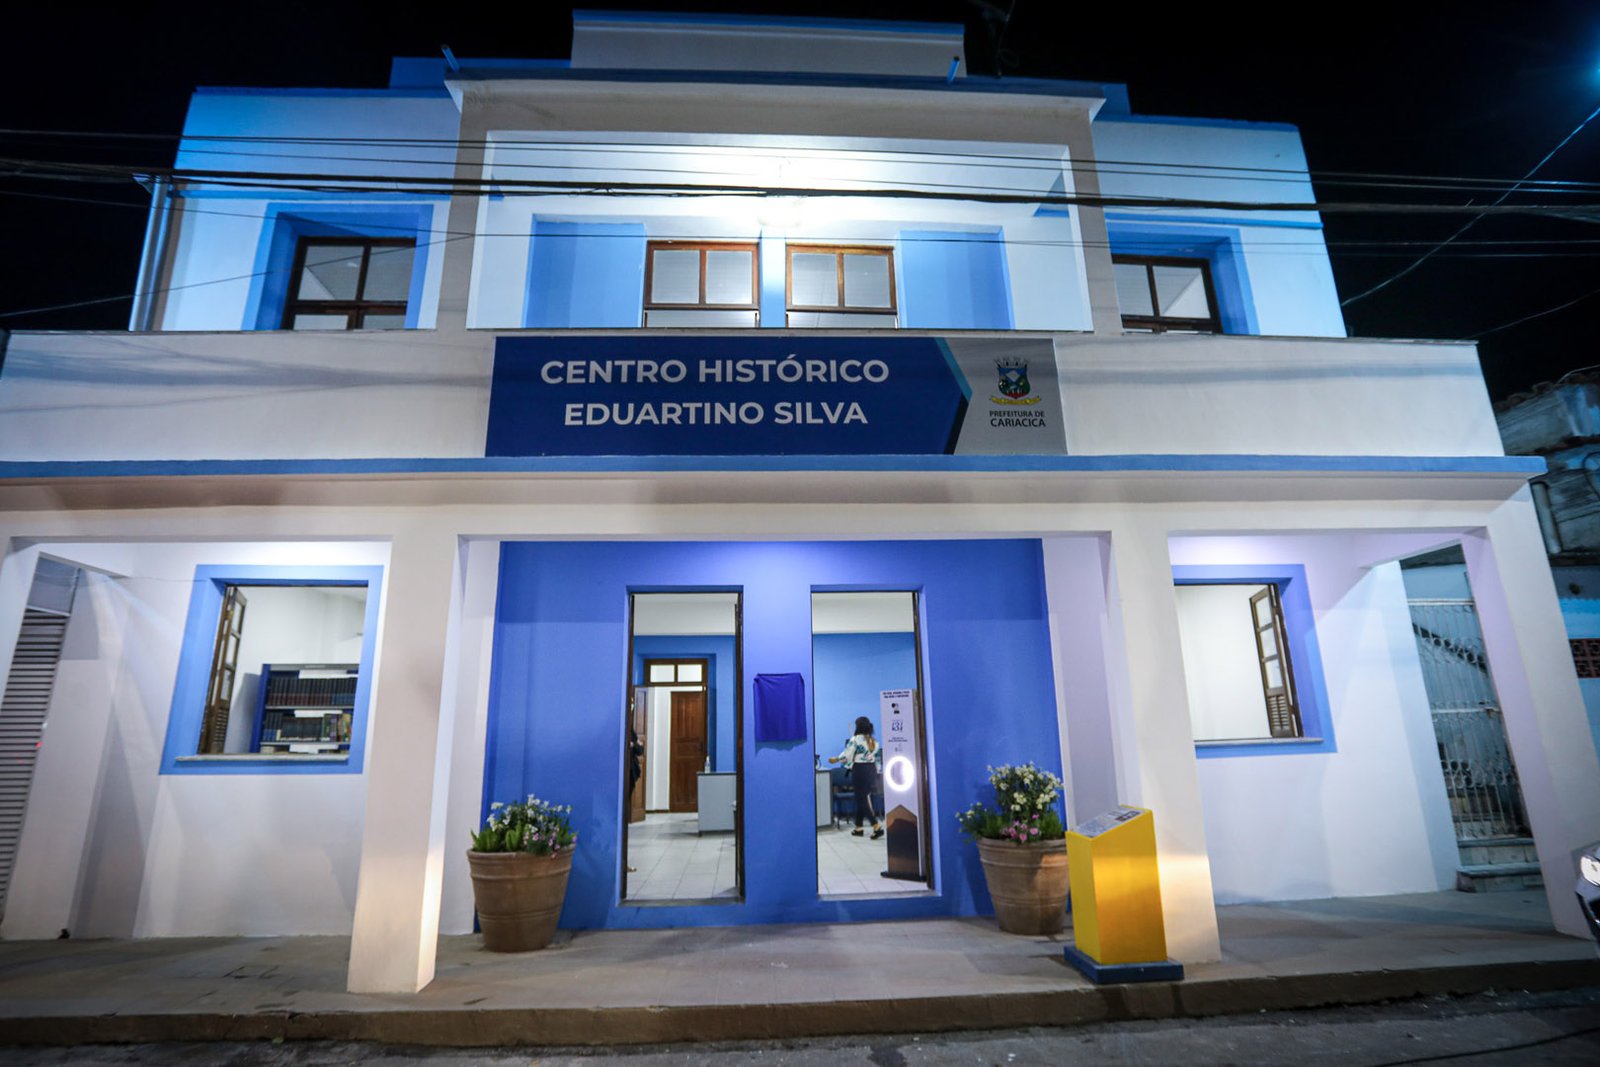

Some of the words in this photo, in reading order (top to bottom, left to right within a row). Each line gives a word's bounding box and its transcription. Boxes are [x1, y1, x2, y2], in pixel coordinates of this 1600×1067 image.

[541, 360, 687, 384] CENTRO
[699, 353, 889, 383] HISTÓRICO
[564, 402, 764, 426] EDUARTINO
[774, 401, 868, 424] SILVA
[990, 418, 1046, 427] CARIACICA
